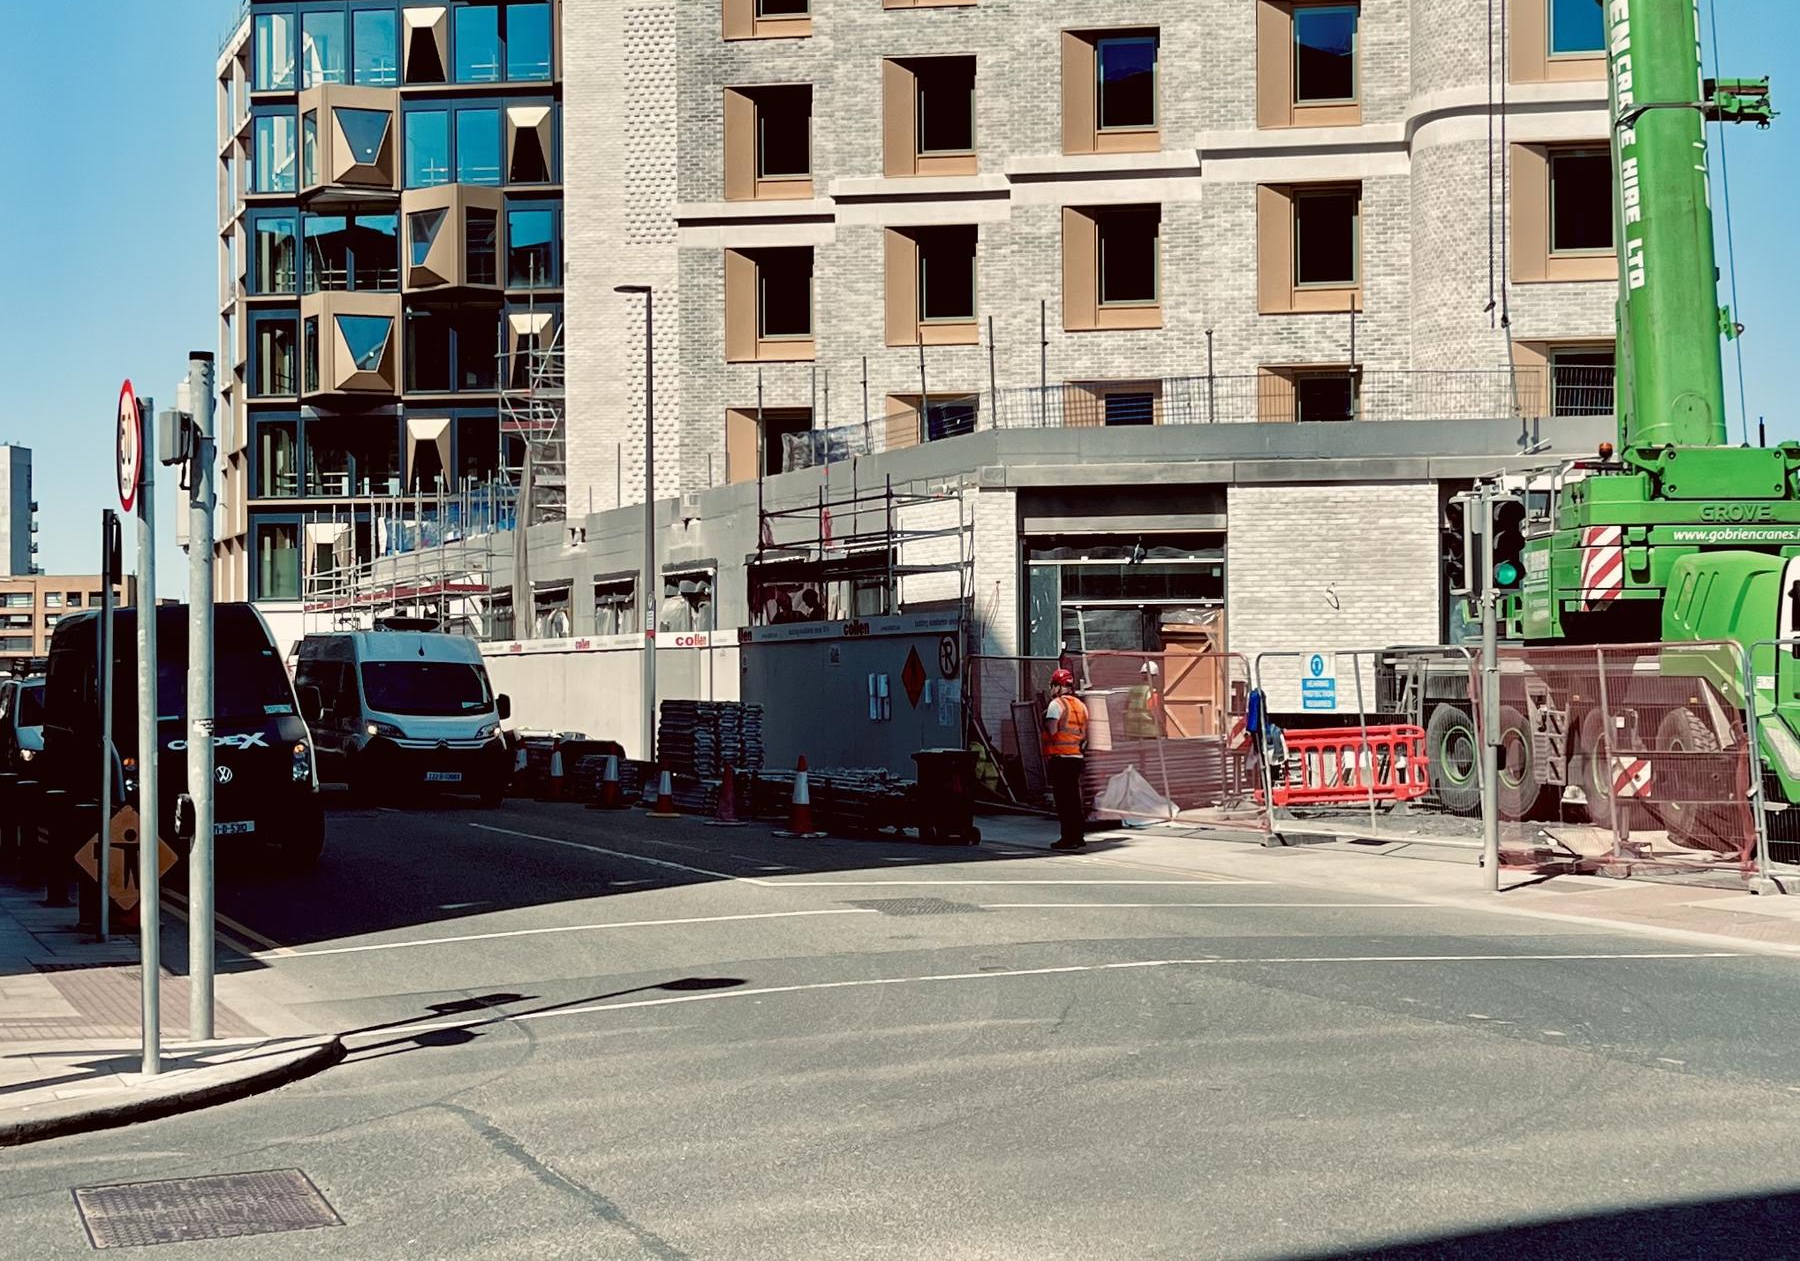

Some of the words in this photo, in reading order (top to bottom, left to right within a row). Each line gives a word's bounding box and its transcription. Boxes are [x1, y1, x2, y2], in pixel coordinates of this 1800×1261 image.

[1622, 156, 1641, 226] HIRE
[1627, 237, 1646, 290] LTD
[1700, 503, 1775, 522] GROVE
[843, 617, 870, 636] collen
[675, 633, 707, 647] collen
[167, 732, 270, 750] CDEX
